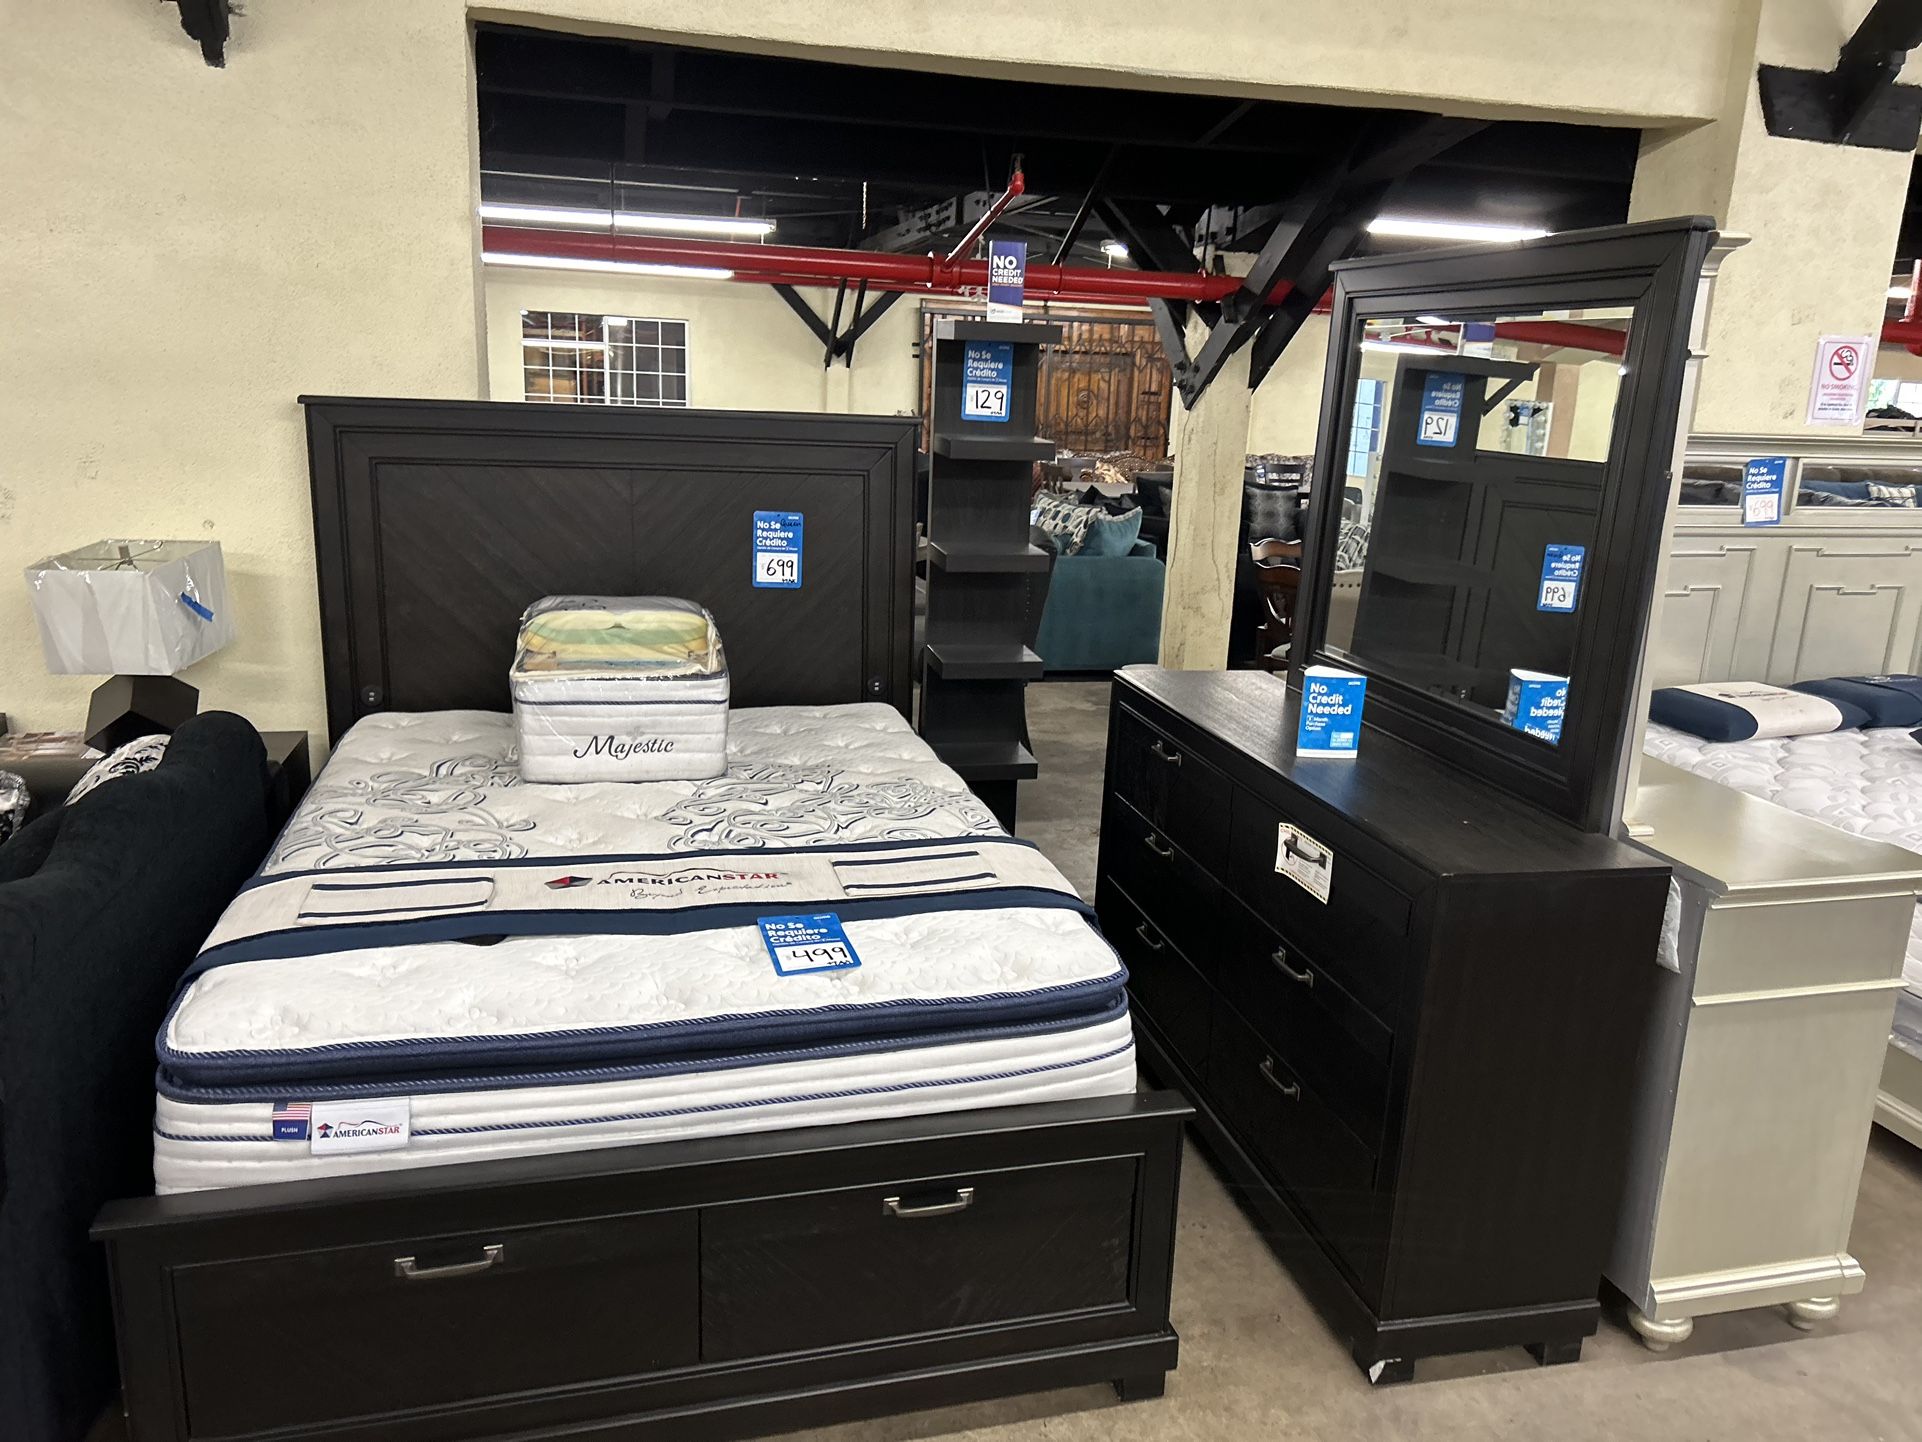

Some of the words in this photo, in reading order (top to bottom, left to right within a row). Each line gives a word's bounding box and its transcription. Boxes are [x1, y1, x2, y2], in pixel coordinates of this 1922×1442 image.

[992, 255, 1017, 270] NO
[992, 269, 1022, 277] CREDIT
[992, 276, 1024, 284] NEEDED
[968, 350, 980, 359] No
[981, 350, 992, 360] Se
[968, 359, 1004, 370] Requiere
[967, 368, 997, 378] Crédito
[975, 389, 1004, 412] 129
[1759, 466, 1768, 474] Se
[1747, 474, 1777, 482] Requiere
[756, 520, 770, 529] No
[770, 520, 781, 530] Se
[756, 529, 794, 539] Requiere
[756, 538, 788, 547] Crédito
[766, 558, 794, 578] 699
[1310, 682, 1328, 694] No
[1308, 693, 1344, 704] Credit
[1307, 703, 1352, 715] Needed
[572, 734, 674, 760] Majestic
[597, 872, 779, 886] AMERICANSTAR
[767, 928, 828, 937] Requiere
[770, 934, 821, 943] Crédito
[792, 946, 848, 962] 499
[332, 1126, 400, 1139] AMERICANSTAR
